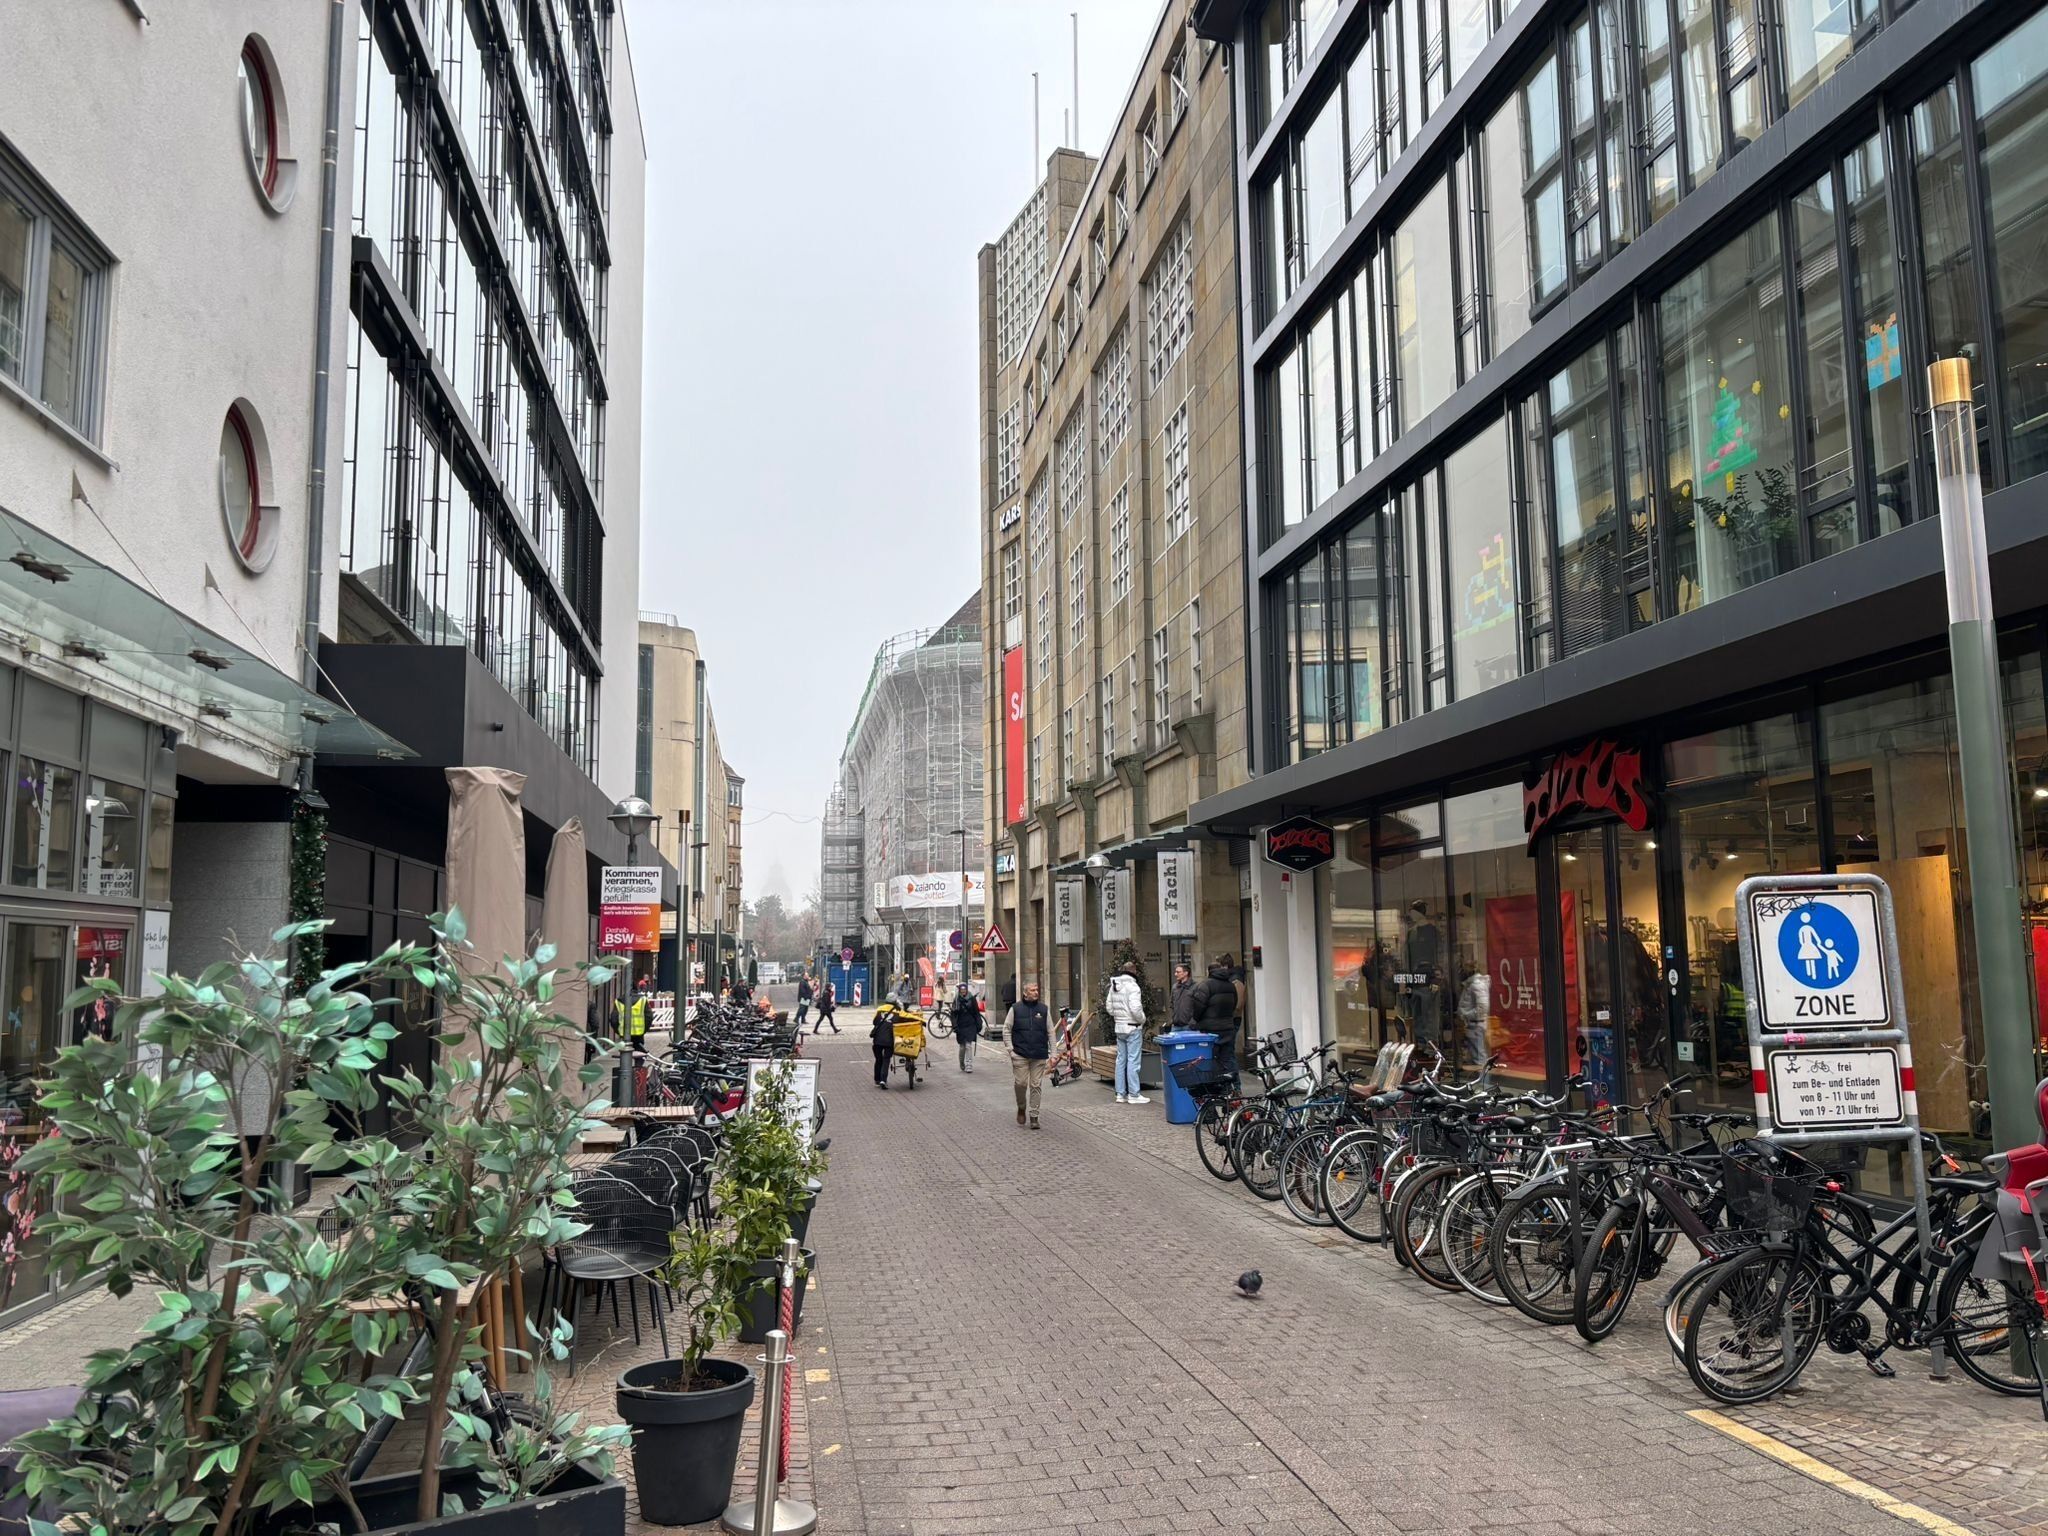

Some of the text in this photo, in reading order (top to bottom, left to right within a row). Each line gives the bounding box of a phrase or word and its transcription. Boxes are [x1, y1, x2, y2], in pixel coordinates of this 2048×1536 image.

[605, 869, 659, 877] Kommunen
[605, 878, 653, 886] verarmen,
[914, 881, 946, 892] zalando
[1163, 857, 1178, 911] Fachl
[604, 885, 657, 894] Kriegskasse
[603, 894, 632, 903] gefüllt!
[1059, 886, 1070, 926] Fachl
[605, 933, 635, 944] BSW
[1413, 974, 1427, 984] STAY
[1794, 994, 1857, 1016] ZONE
[1837, 1062, 1852, 1072] frei
[1792, 1077, 1880, 1089] zum Be- und Entladen
[1800, 1094, 1815, 1102] von
[1816, 1092, 1822, 1102] 8
[1832, 1091, 1840, 1101] 11
[1844, 1091, 1858, 1101] Uhr
[1861, 1090, 1876, 1100] und
[1799, 1108, 1815, 1116] von
[1816, 1106, 1826, 1115] 19
[1836, 1105, 1846, 1115] 21
[1848, 1105, 1862, 1114] Uhr
[1864, 1103, 1880, 1114] frei
